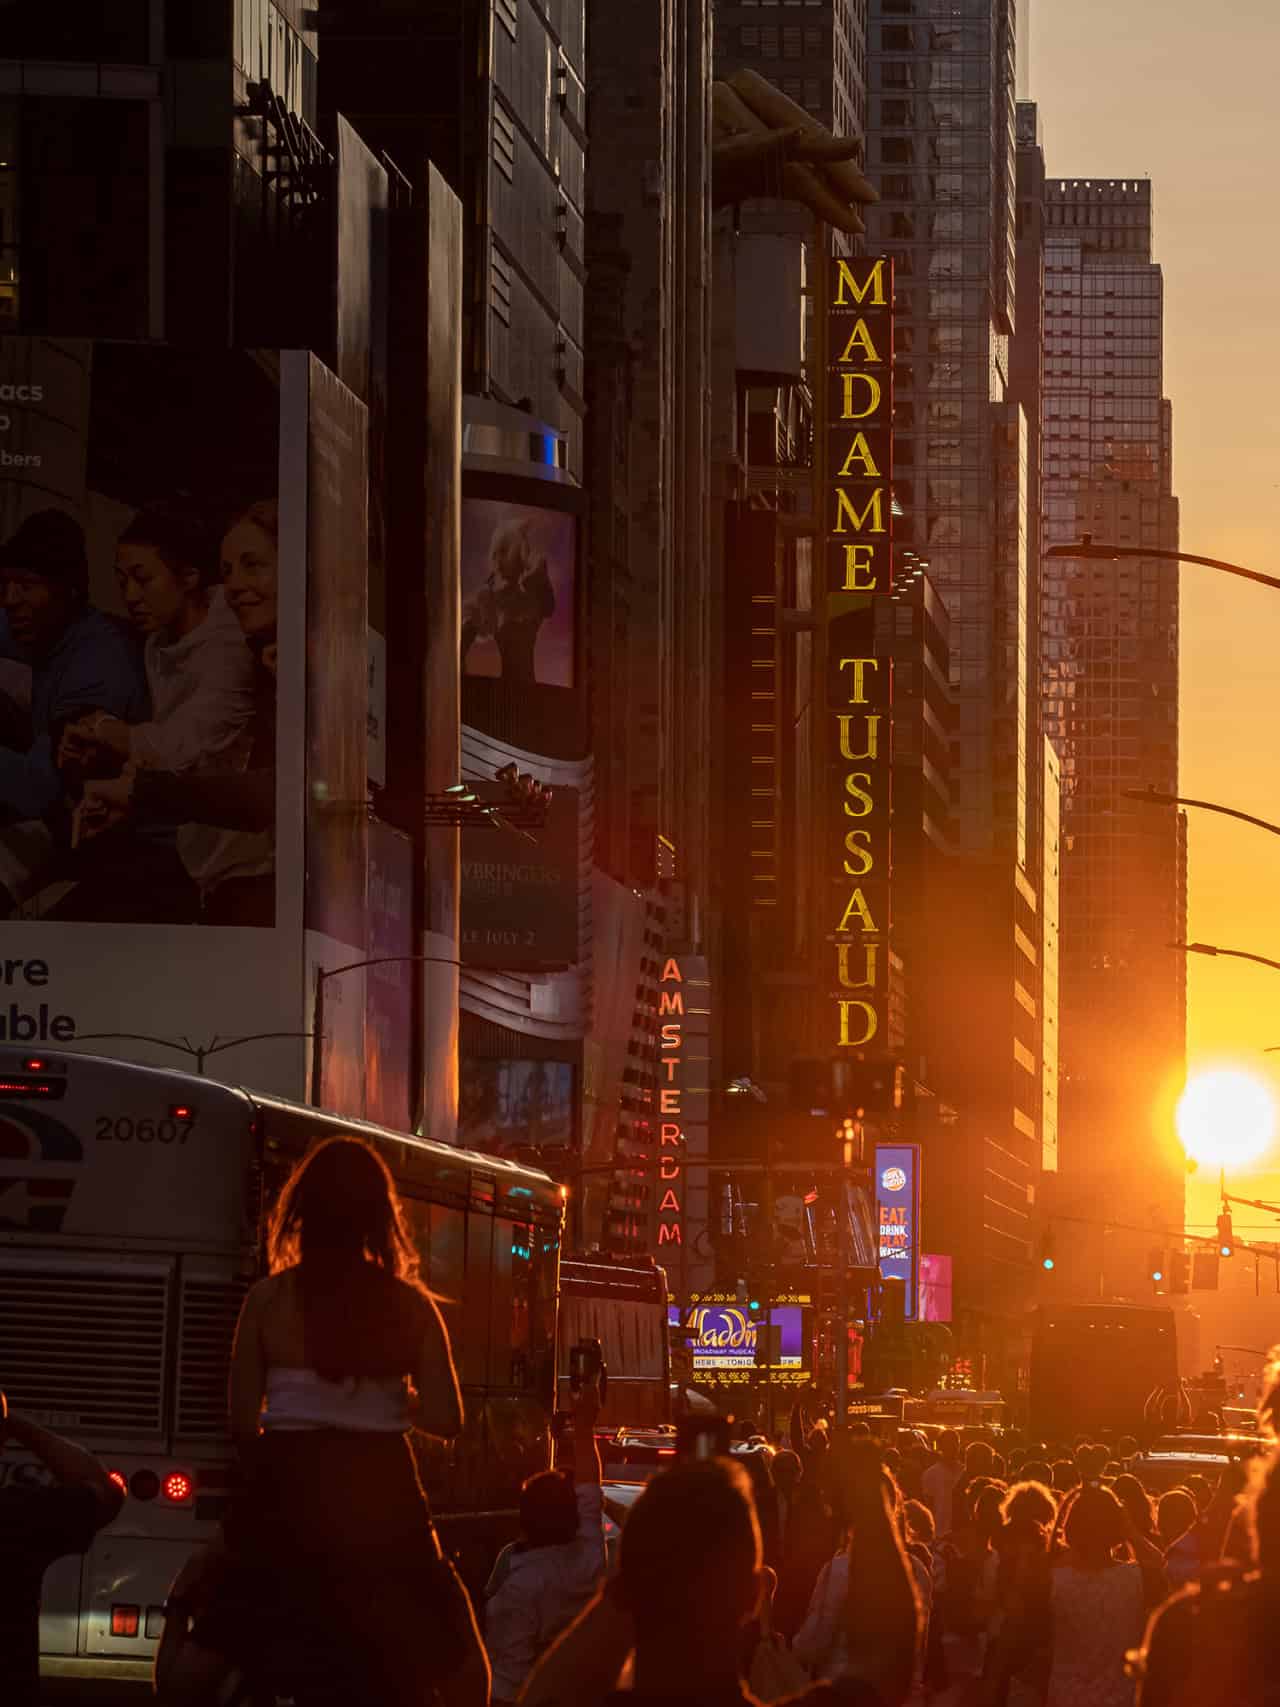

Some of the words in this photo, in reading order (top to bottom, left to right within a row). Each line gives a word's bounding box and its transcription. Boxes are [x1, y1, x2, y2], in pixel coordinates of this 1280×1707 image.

[832, 259, 888, 592] MADAME
[836, 656, 881, 1048] TUSSAUD
[0, 958, 48, 986] re
[0, 1004, 76, 1042] ble
[656, 957, 684, 1246] AMSTERDAM
[95, 1116, 194, 1145] 20607
[880, 1207, 908, 1225] EAT.
